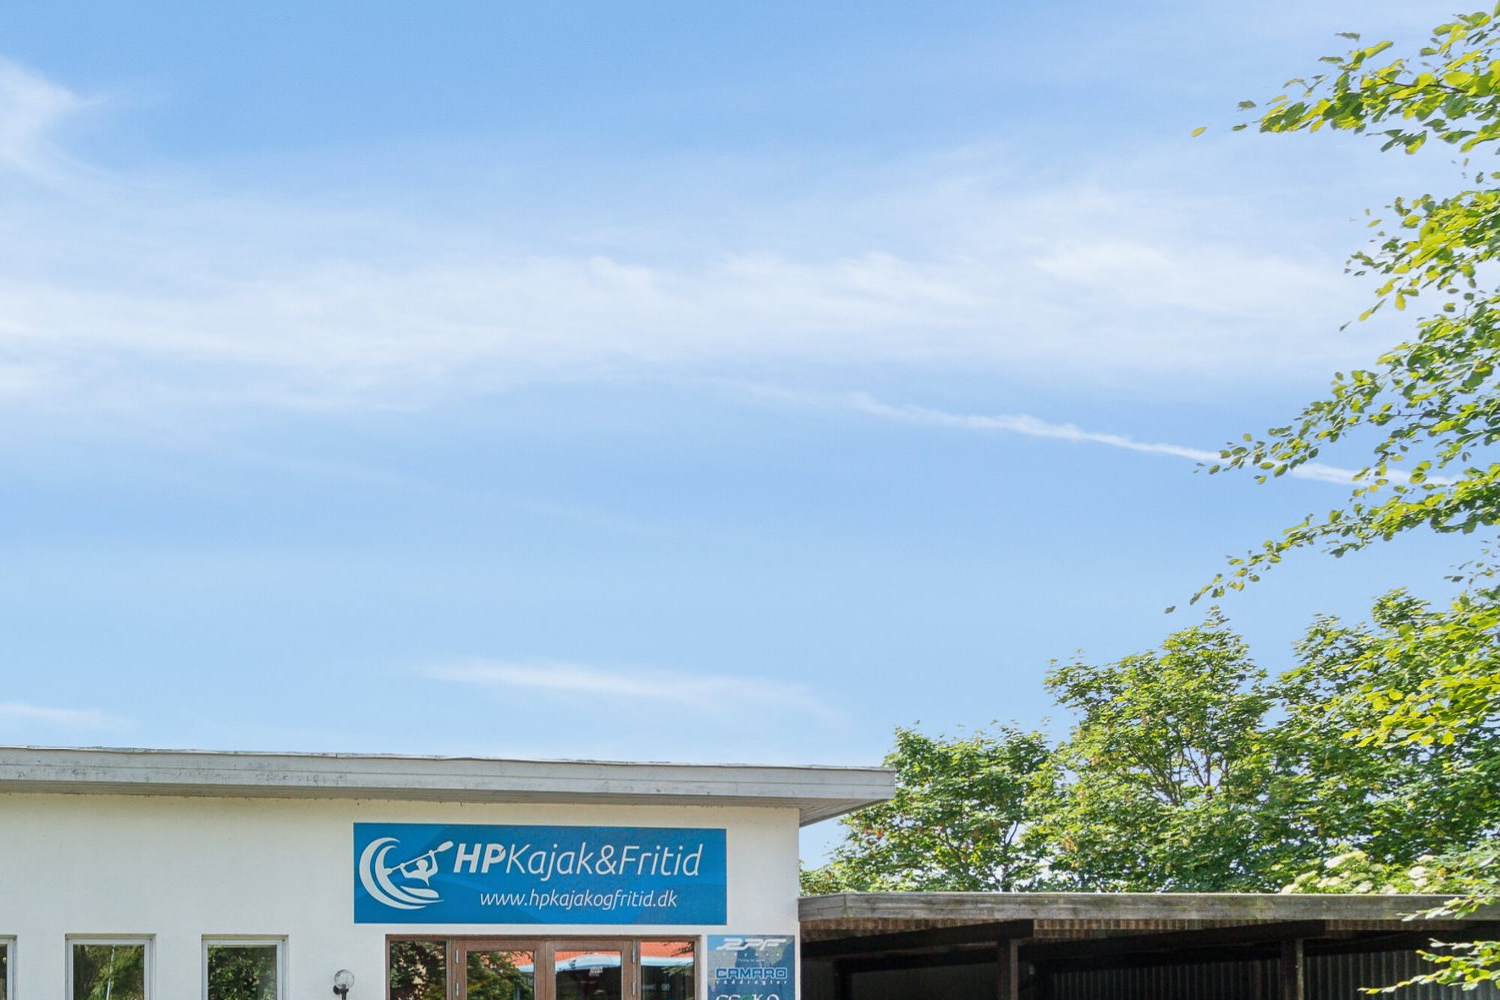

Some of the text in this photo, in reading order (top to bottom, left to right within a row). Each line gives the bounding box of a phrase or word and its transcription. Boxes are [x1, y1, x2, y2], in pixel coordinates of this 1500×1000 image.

[453, 842, 703, 882] HPKajak&Fritid
[479, 889, 678, 911] www.hpkajakogfritid.dk
[714, 967, 788, 979] CAMARO
